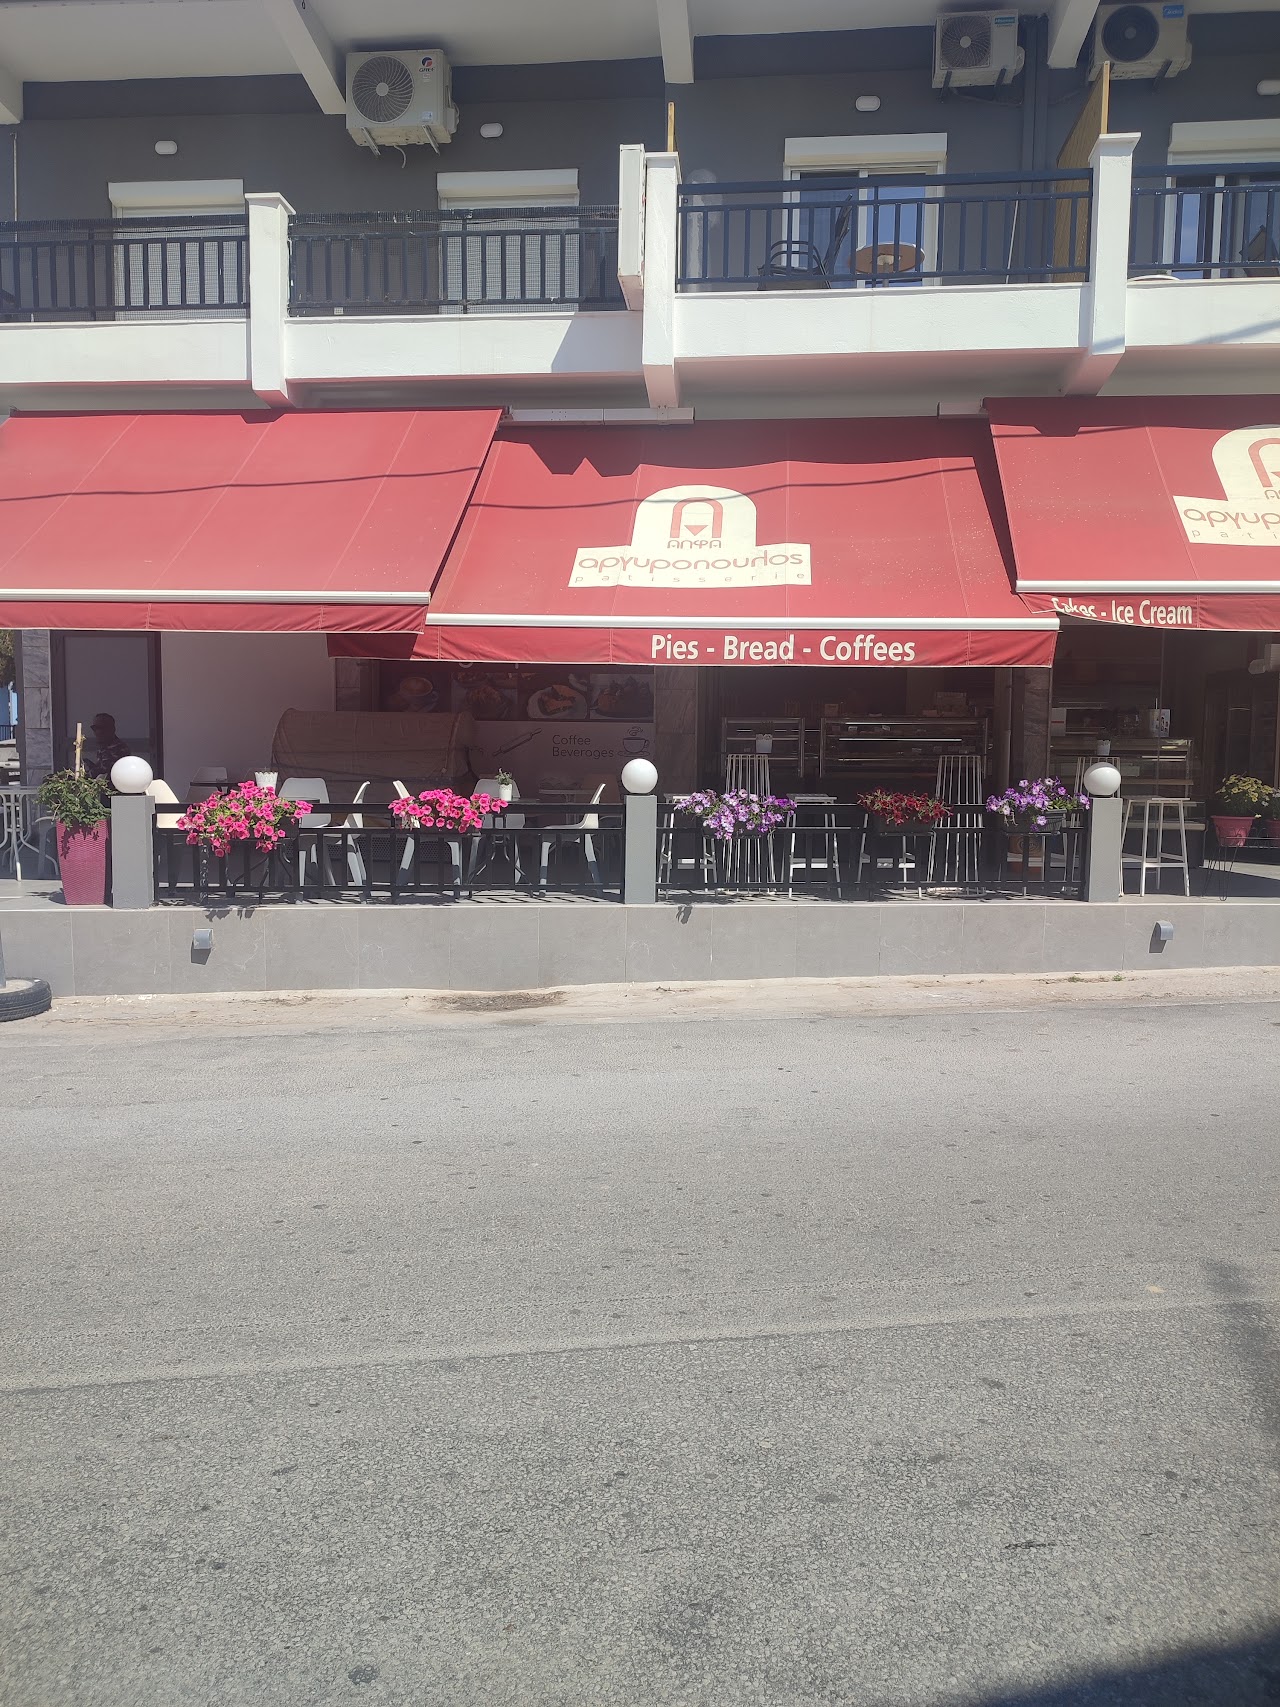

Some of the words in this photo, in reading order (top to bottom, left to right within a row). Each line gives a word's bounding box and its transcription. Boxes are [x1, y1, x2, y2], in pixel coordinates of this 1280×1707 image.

[1111, 600, 1134, 623] Ice
[1139, 600, 1193, 625] Cream
[651, 633, 699, 660] Pies
[723, 634, 795, 660] Bread
[819, 634, 916, 661] Coffees
[552, 734, 591, 746] Coffee
[552, 747, 614, 760] Beverages
